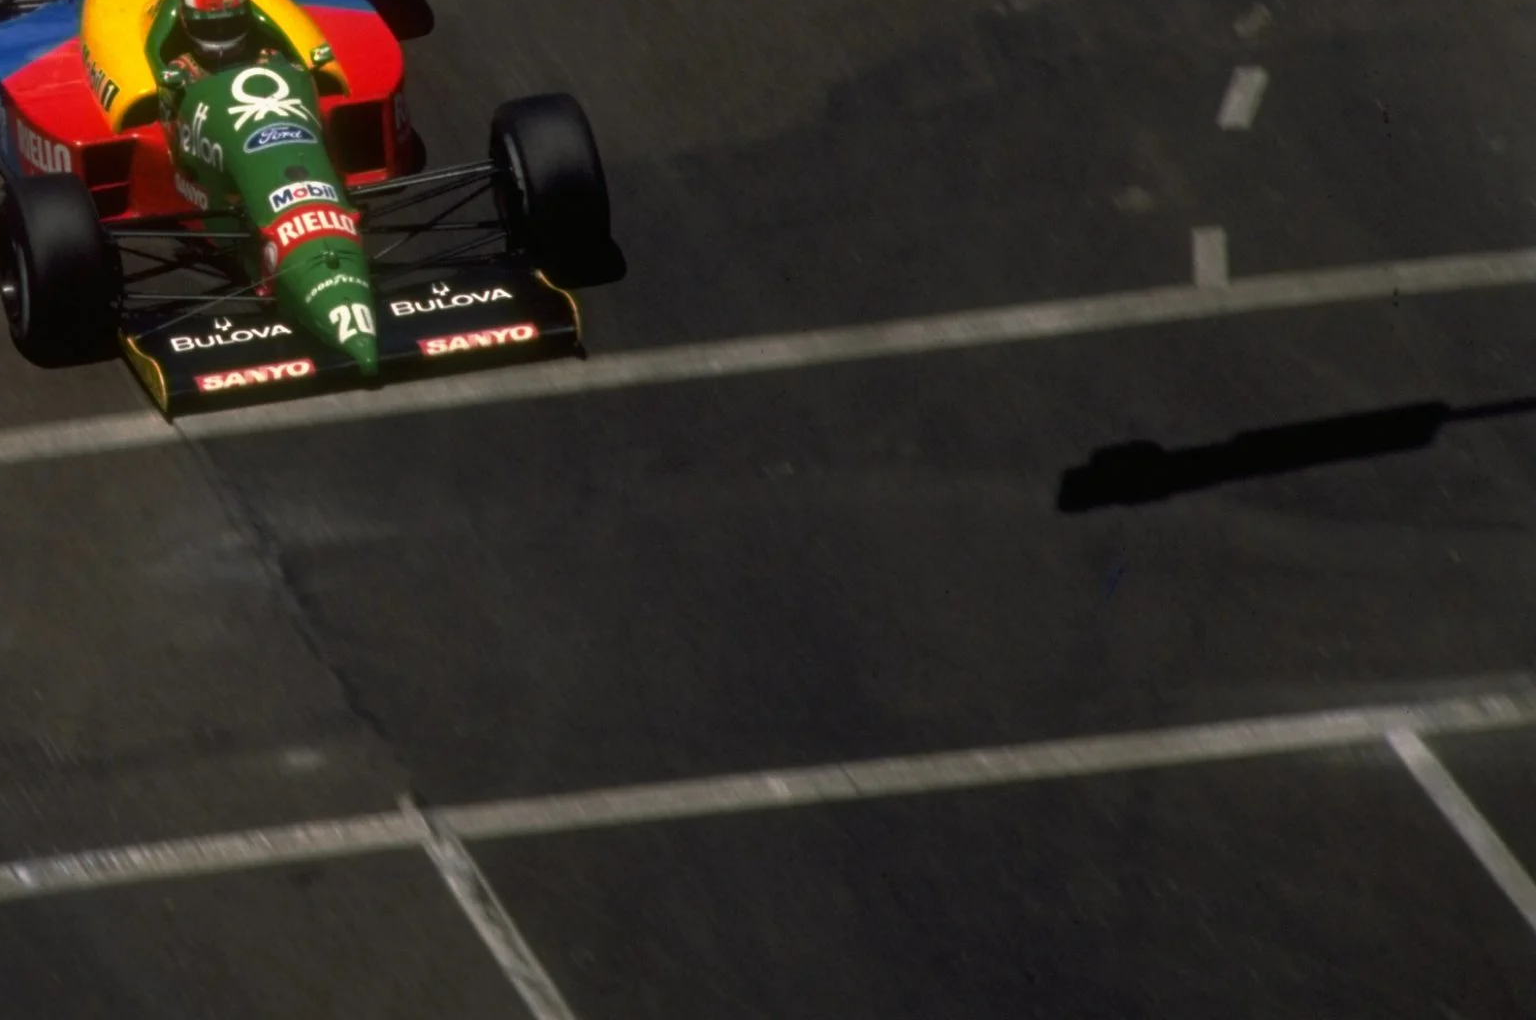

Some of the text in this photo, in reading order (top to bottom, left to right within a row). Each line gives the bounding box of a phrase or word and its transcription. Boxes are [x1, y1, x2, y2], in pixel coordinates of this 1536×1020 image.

[258, 126, 303, 145] Ford
[271, 183, 337, 209] Mobil
[276, 209, 357, 247] RIELLO
[389, 287, 513, 317] BULOVA
[170, 323, 293, 353] BULOVA
[328, 302, 376, 345] 20
[425, 324, 534, 356] SANYO
[202, 360, 311, 392] SANYO
